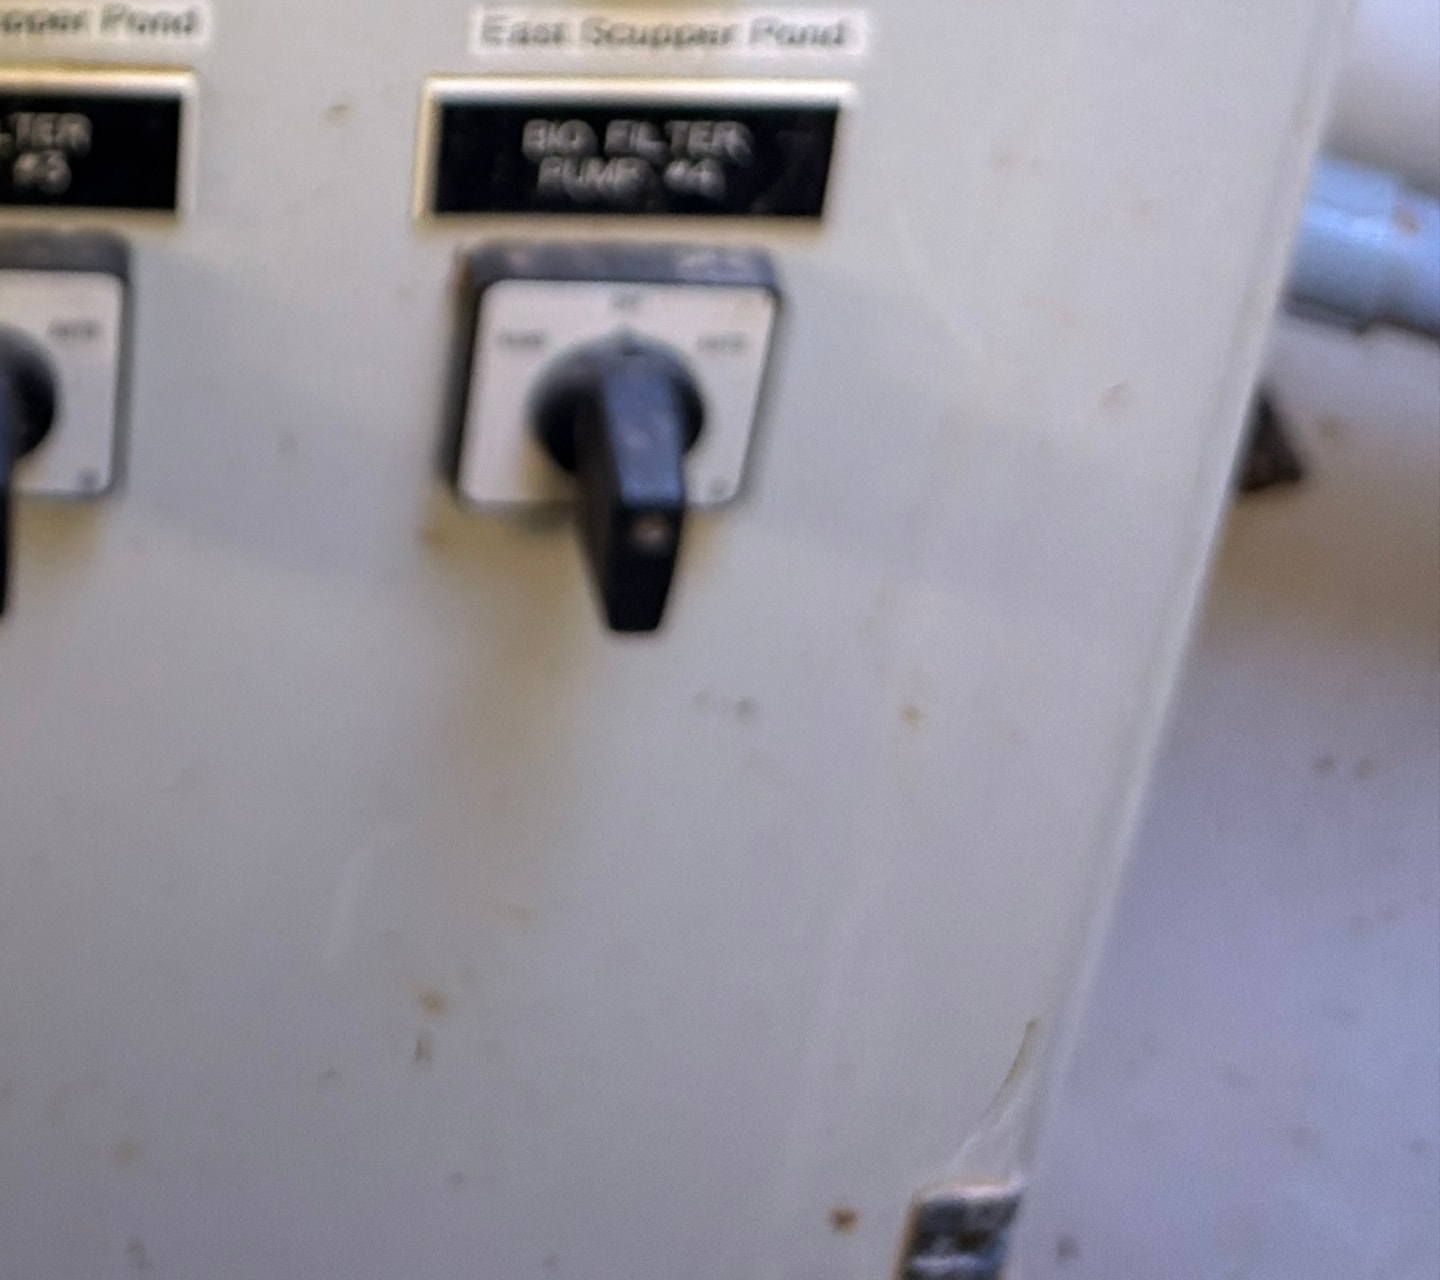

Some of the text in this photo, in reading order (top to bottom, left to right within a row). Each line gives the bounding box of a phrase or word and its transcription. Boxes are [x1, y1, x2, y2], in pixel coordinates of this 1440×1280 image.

[101, 1, 200, 36] Pond
[479, 13, 850, 51] East Scupper Pond
[521, 118, 755, 168] BIO FILTER
[537, 155, 658, 204] PUMP
